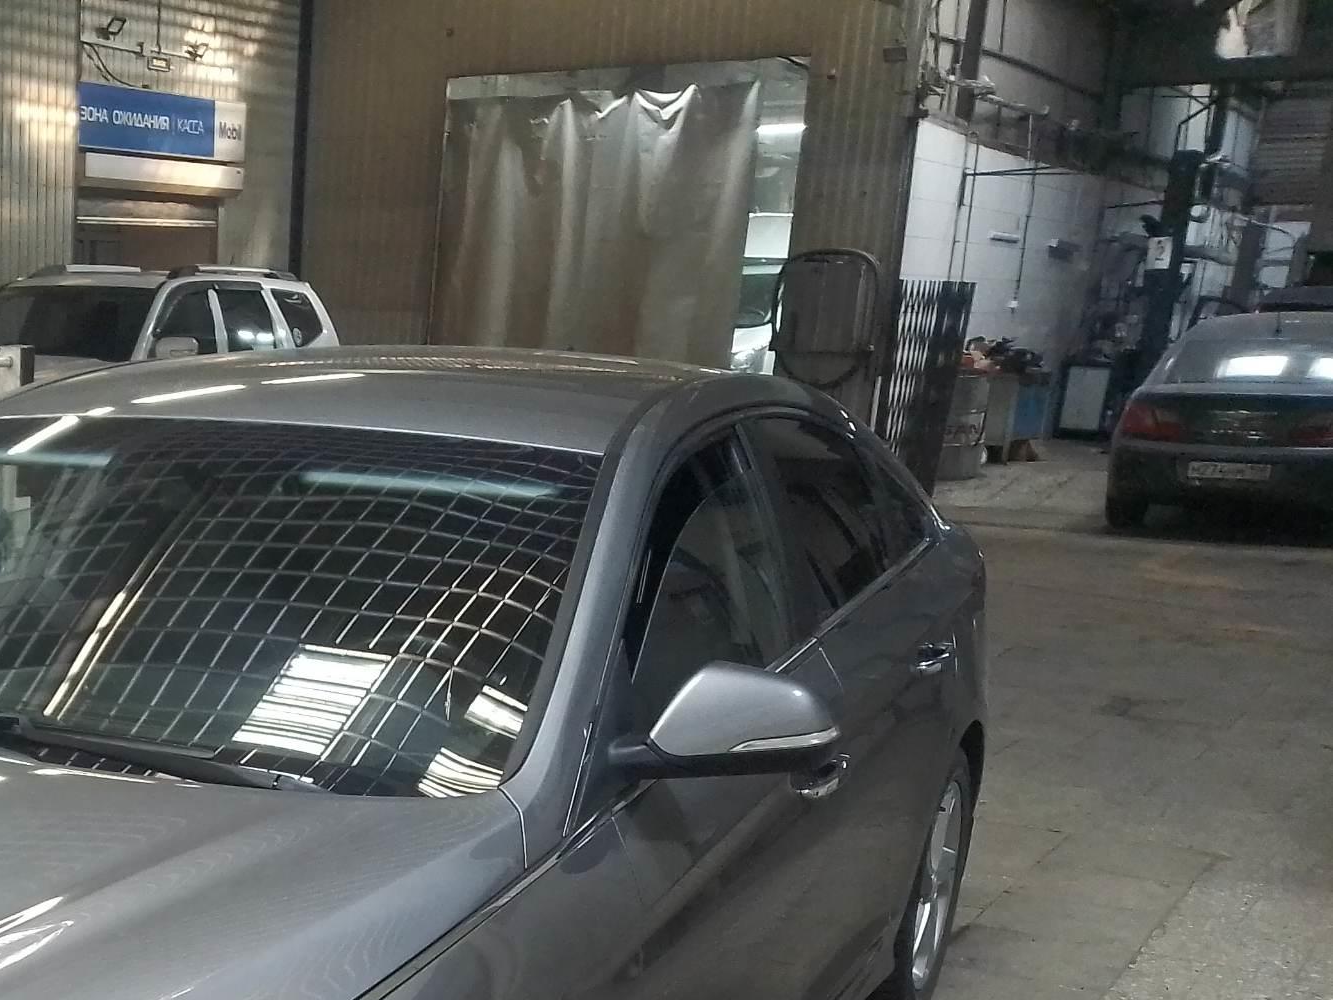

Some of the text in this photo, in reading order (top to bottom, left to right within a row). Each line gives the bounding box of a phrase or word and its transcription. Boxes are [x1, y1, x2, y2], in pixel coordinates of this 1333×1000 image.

[80, 105, 204, 135] ЗОНА ОЖИДАНИЯ КАССА
[218, 121, 242, 141] Mobil
